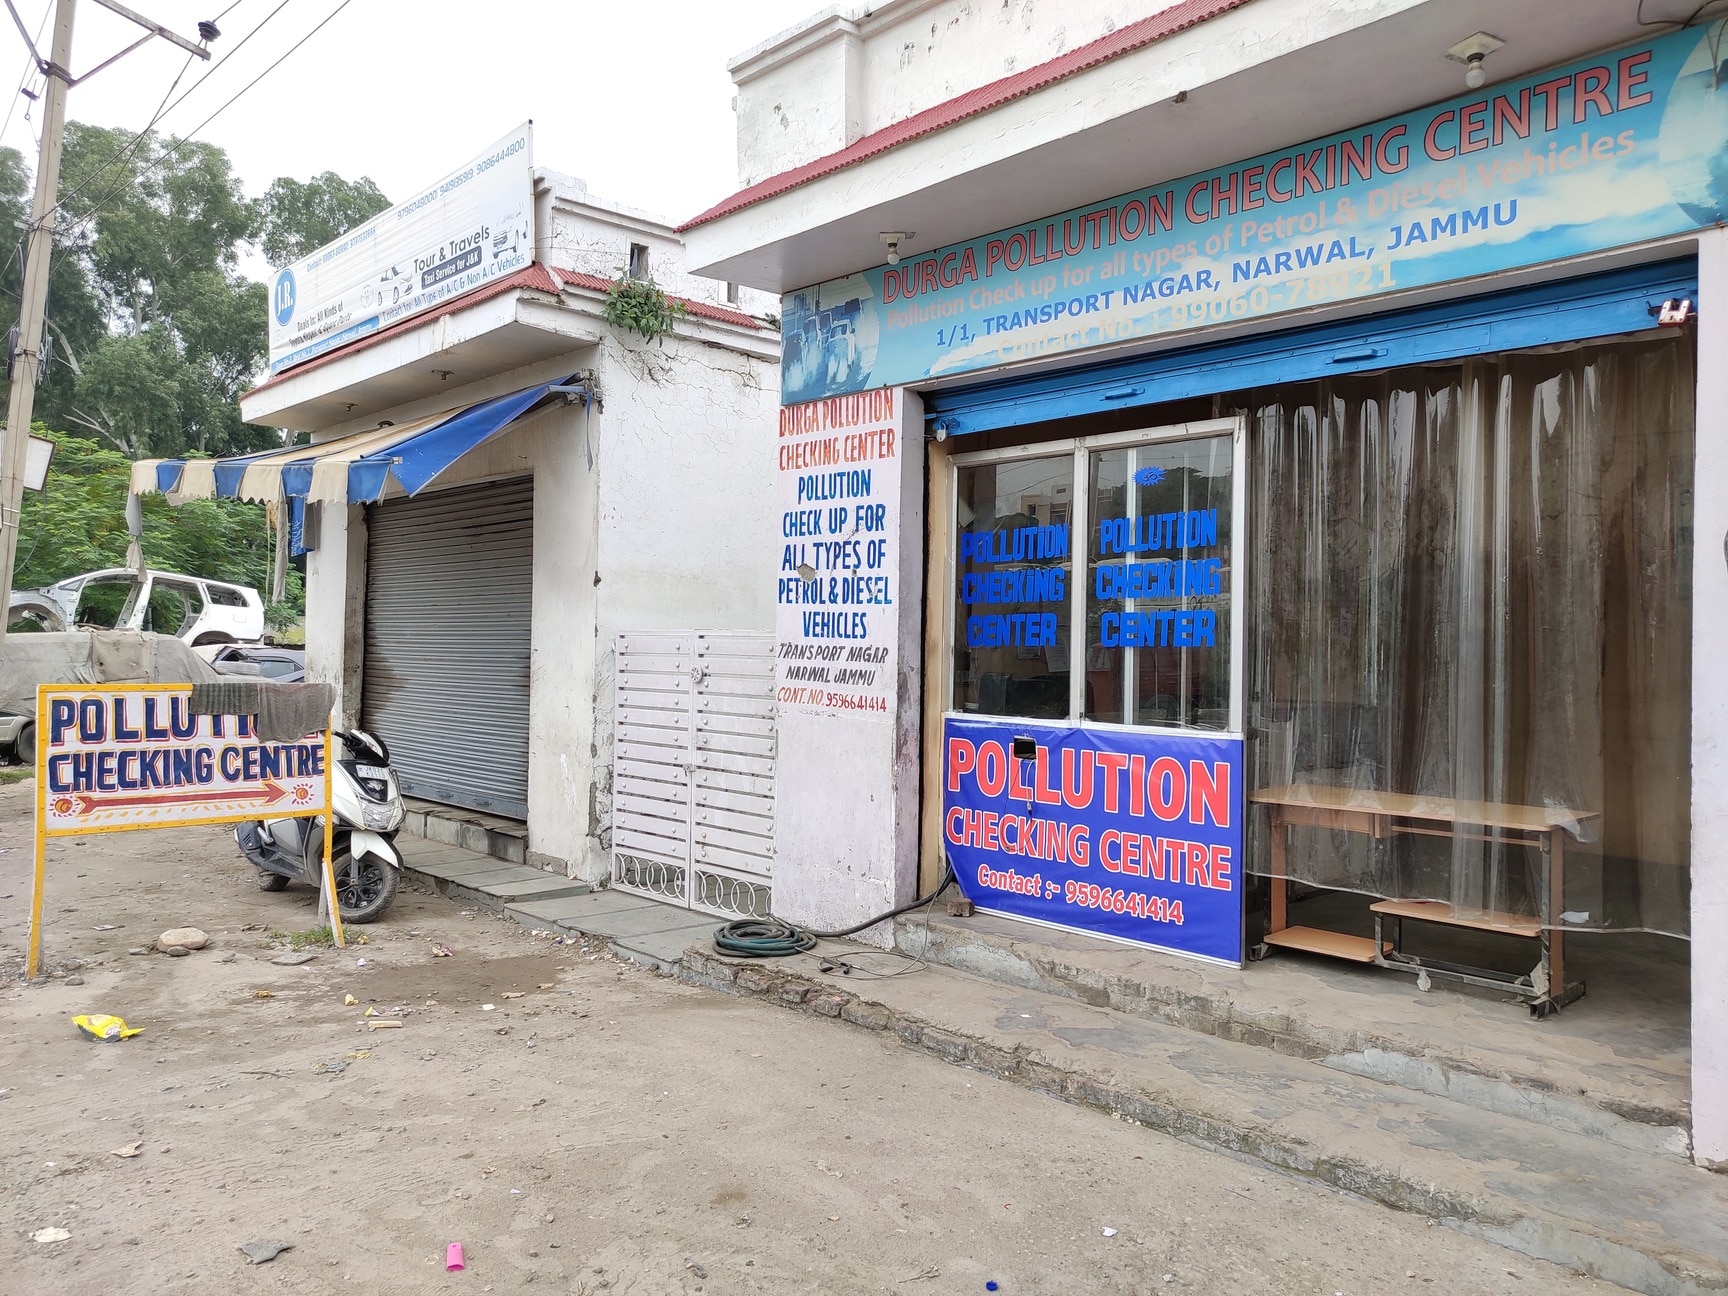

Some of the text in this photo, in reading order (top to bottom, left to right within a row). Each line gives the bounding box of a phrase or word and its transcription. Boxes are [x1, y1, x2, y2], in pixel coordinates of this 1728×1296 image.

[477, 137, 525, 176] 9086444800
[883, 50, 1653, 304] DURGA POLLUTION CHECKING CENTRE
[414, 225, 490, 273] Tour & Travels
[888, 129, 1636, 330] Pollution Check up for all types of Petrol & Diesel Vehicles
[422, 290, 437, 306] Type
[438, 286, 445, 298] of
[467, 272, 480, 286] Non
[496, 252, 525, 273] Vehicles
[423, 250, 479, 286] Taxi Service for J&K
[936, 198, 1518, 348] 1/1, TRANSPORT NAGAR, NARWAL, JAMMU
[277, 281, 294, 317] J.R.
[998, 321, 1090, 360] Contact
[1099, 316, 1141, 340] No.
[1170, 261, 1396, 328] 99060-78921
[779, 388, 894, 437] DURGA POLLUTION
[779, 428, 896, 471] CHECKING CENTER
[798, 469, 871, 505] POLLUTION
[783, 504, 886, 538] CHECK UP FOR
[813, 540, 862, 570] TYPES
[867, 539, 887, 569] OF
[778, 576, 892, 605] PETROL & DIESEL
[803, 611, 867, 639] VEHICLES
[967, 612, 1058, 648] CENTER
[1101, 610, 1216, 648] CENTER
[777, 643, 889, 664] TRANSPORT NAGAR
[785, 665, 876, 687] NARWAL JAMMU
[826, 692, 887, 712] 9596641414
[48, 742, 325, 793] CHECKING CENTRE
[948, 737, 1231, 828] POLLUTION
[946, 806, 1232, 891] CHECKING CENTRE
[977, 864, 1042, 898] Contact
[1065, 880, 1184, 925] 9596641414
